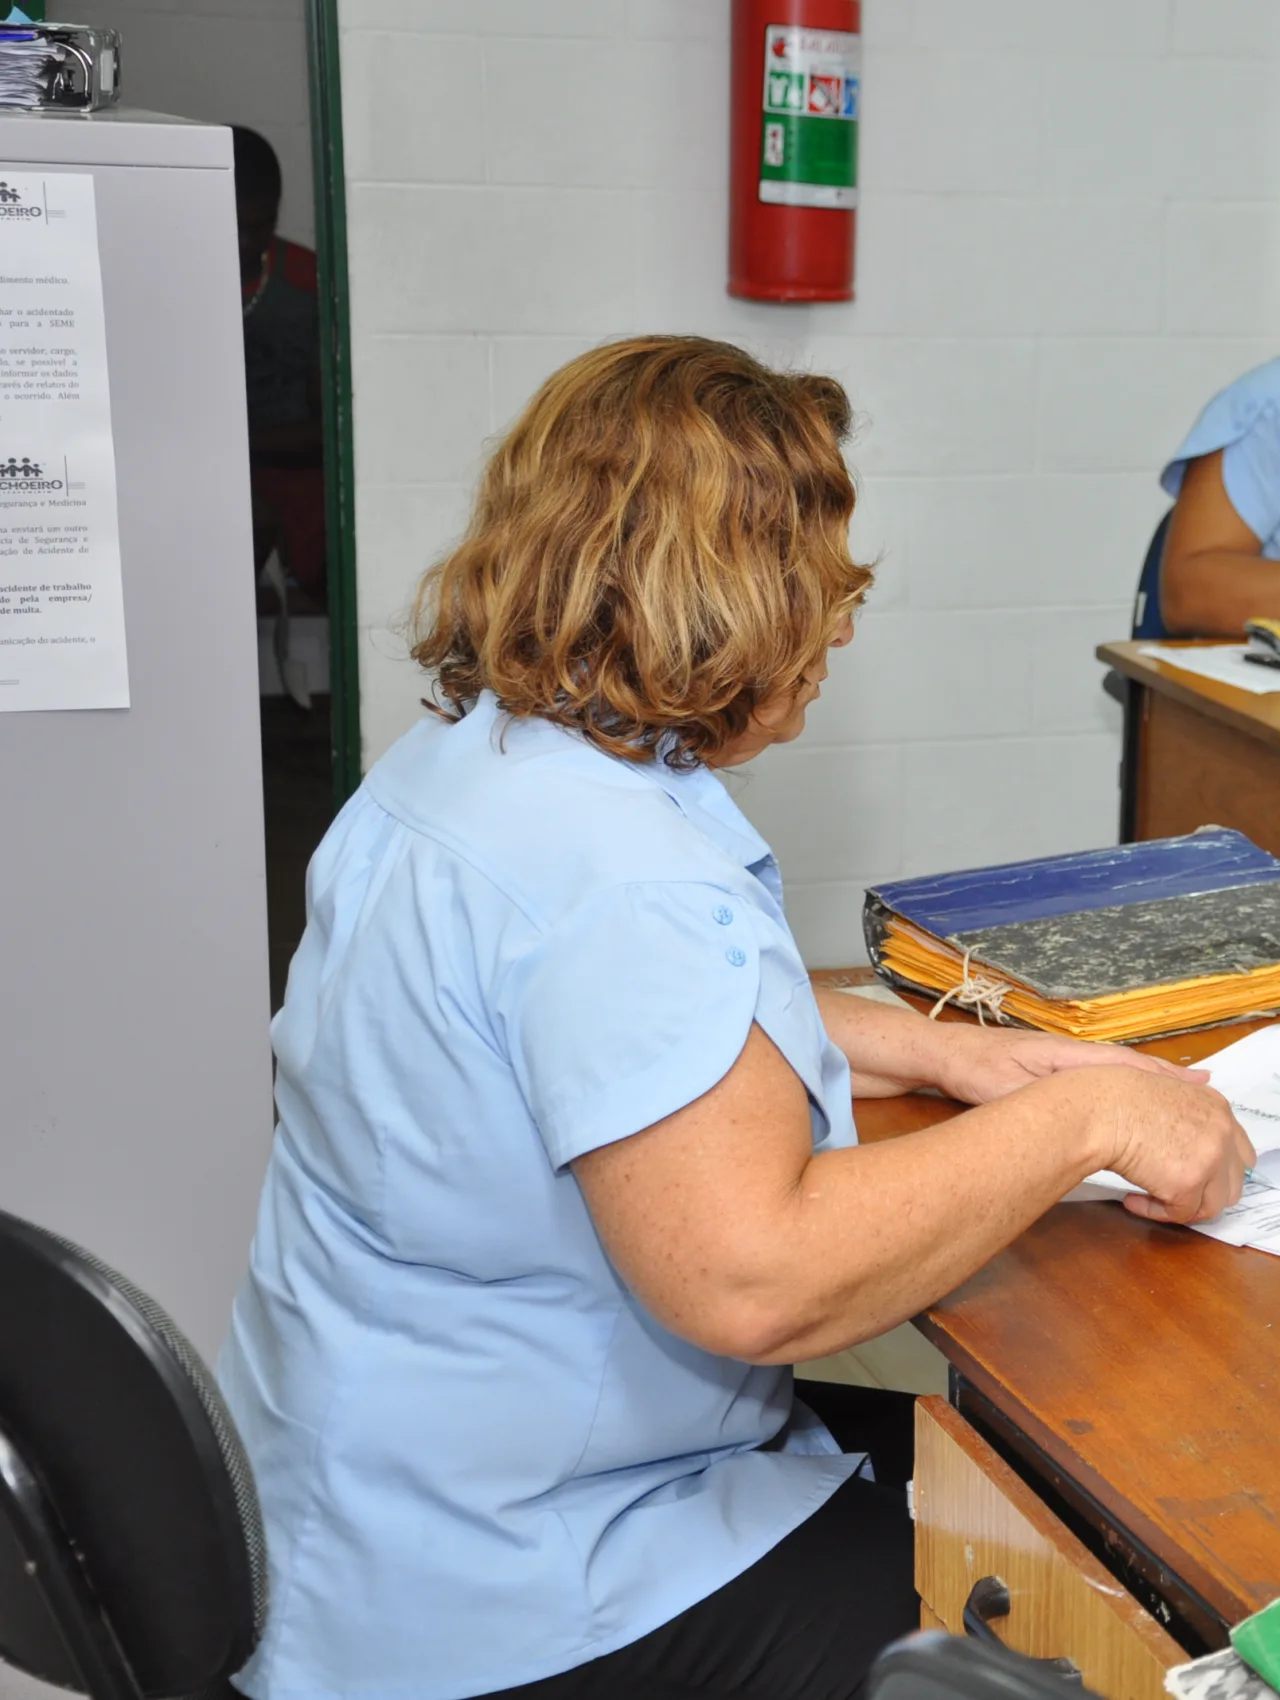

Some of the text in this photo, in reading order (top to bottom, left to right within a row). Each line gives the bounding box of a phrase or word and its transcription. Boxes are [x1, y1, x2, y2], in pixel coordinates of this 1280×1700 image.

[26, 308, 75, 316] acidentado
[9, 320, 30, 329] para
[52, 369, 79, 378] dados
[23, 381, 34, 389] de
[36, 380, 66, 389] relatos
[68, 380, 80, 388] do
[0, 479, 63, 491] CHOEIRO
[48, 499, 87, 507] Medicina
[11, 525, 44, 534] enviará
[64, 525, 89, 533] outro
[18, 536, 29, 544] de
[34, 536, 78, 546] Segurança
[22, 547, 34, 555] de
[37, 545, 75, 555] Acidente
[78, 545, 90, 554] de
[39, 584, 51, 593] de
[53, 582, 92, 592] trabalho
[20, 594, 40, 605] pela
[13, 605, 43, 615] multa.
[37, 636, 49, 645] do
